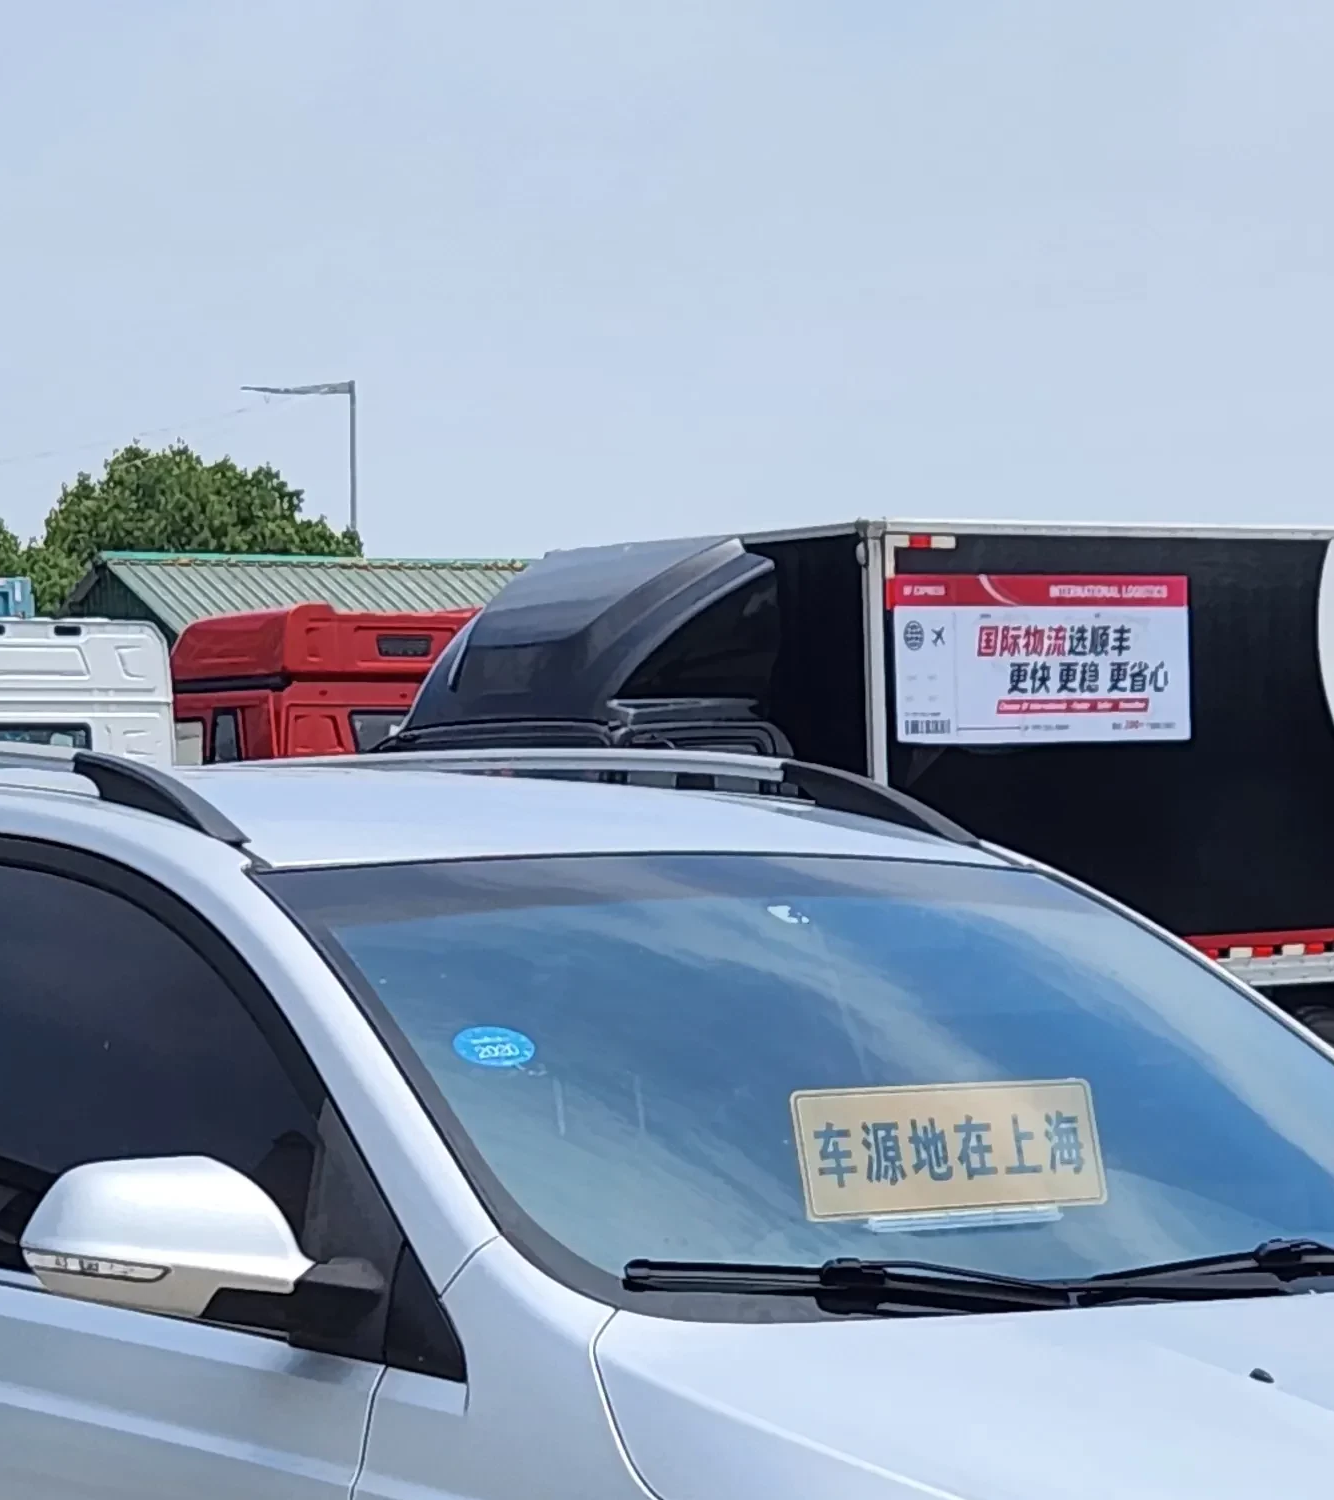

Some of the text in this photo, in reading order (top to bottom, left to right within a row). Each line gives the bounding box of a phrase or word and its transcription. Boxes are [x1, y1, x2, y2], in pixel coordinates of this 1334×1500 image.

[977, 624, 1132, 657] 国际物流选顺丰
[1007, 661, 1169, 694] 更快 更稳 更省心
[813, 1110, 1085, 1188] 车源地在上海
